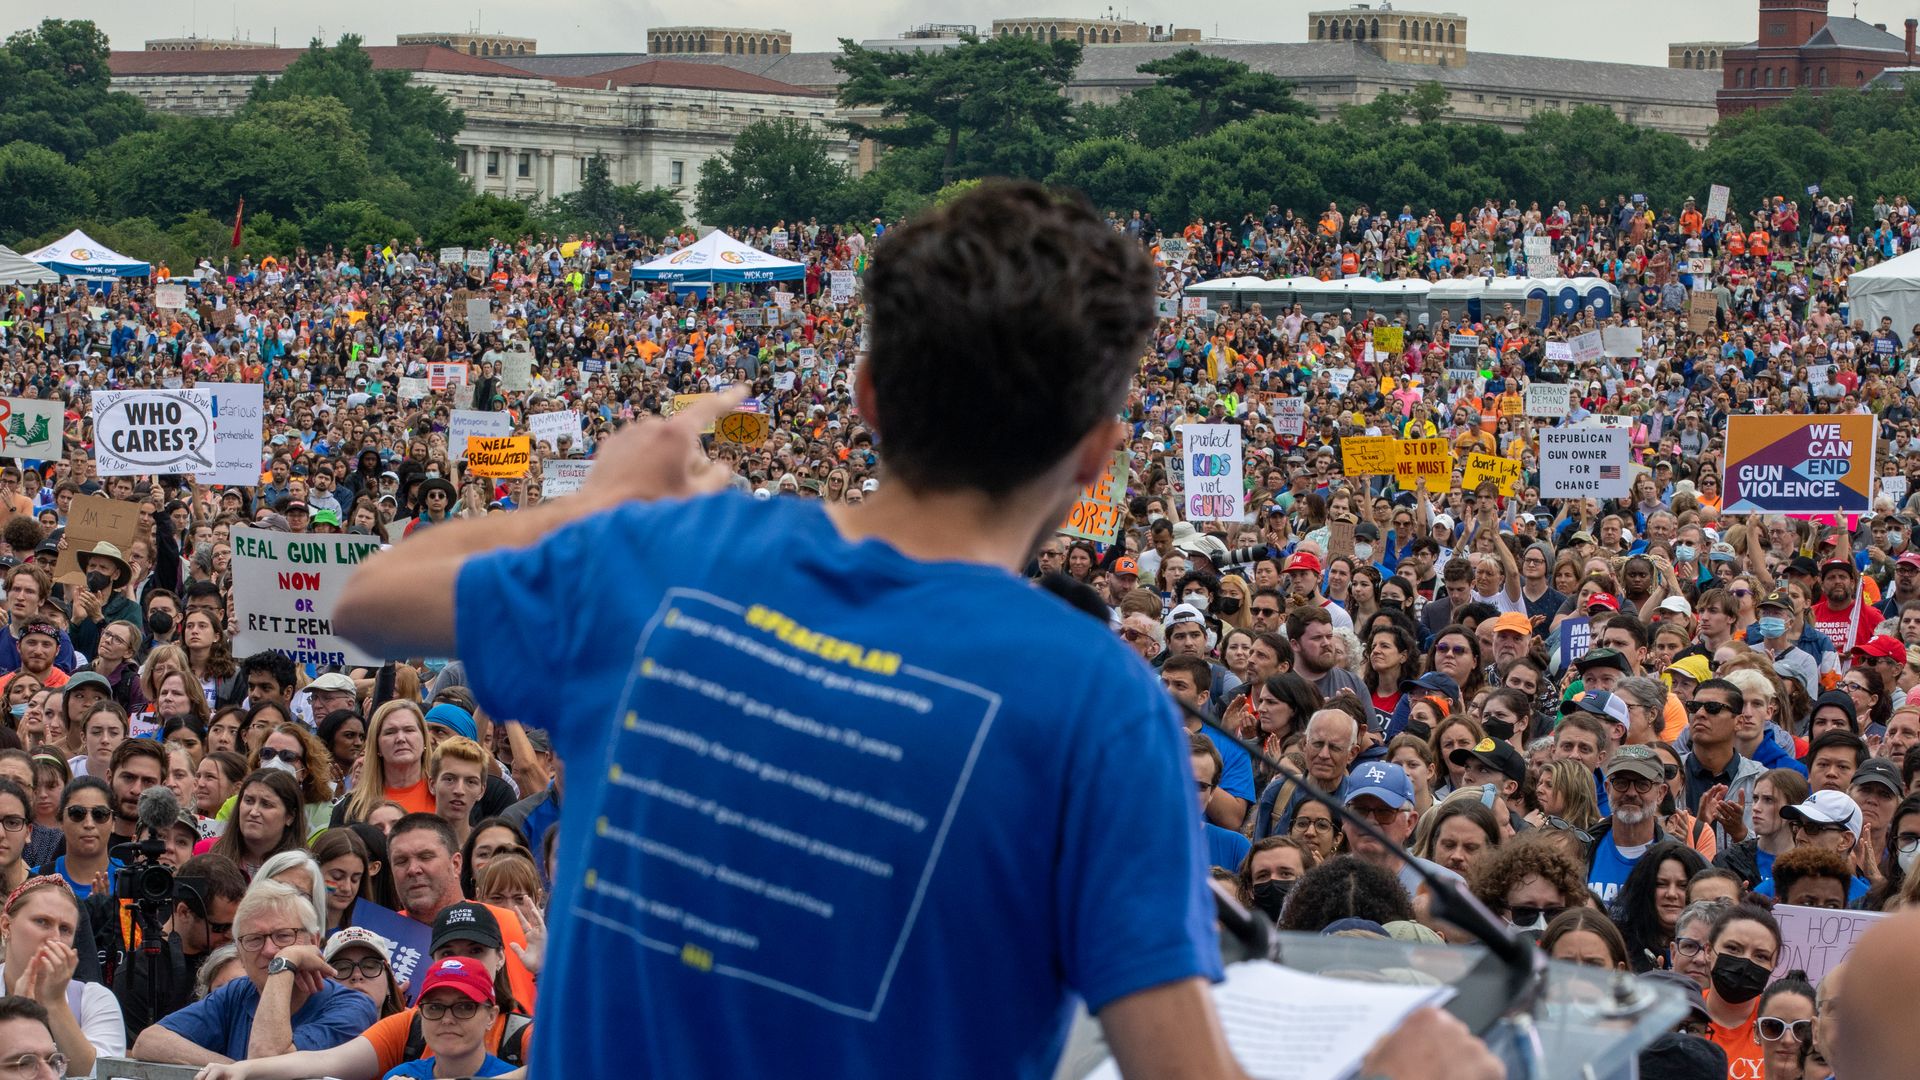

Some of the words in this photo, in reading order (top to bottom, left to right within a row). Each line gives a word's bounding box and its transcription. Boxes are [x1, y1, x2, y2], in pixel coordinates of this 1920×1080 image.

[658, 272, 684, 281] WCK.org
[744, 271, 774, 280] WCK.org
[1450, 370, 1475, 379] ALIVE
[1530, 386, 1567, 395] VETERANS
[212, 397, 257, 418] efarious
[1290, 399, 1301, 407] HEY
[1531, 396, 1563, 405] DEMAND
[124, 402, 181, 425] WHO
[1600, 415, 1618, 424] NRA
[1279, 420, 1298, 428] KILL
[1809, 424, 1841, 440] WE
[112, 427, 198, 452] CARES?
[213, 426, 254, 443] eprehensible
[1190, 428, 1232, 452] protect
[1547, 434, 1612, 443] REPUBLICAN
[1404, 442, 1440, 456] STOP.
[1548, 450, 1568, 460] GUN
[1571, 450, 1607, 460] OWNER
[1808, 441, 1852, 457] CAN
[210, 458, 254, 472] ccomplices
[1192, 453, 1231, 476] KIDS
[1397, 462, 1412, 475] WE
[1416, 461, 1448, 474] MUST.
[1472, 456, 1496, 472] don't
[1500, 462, 1518, 476] look
[1569, 465, 1590, 473] FOR
[1808, 459, 1850, 475] END
[558, 470, 586, 478] REQUIRE
[1739, 465, 1783, 481] GUN
[1200, 477, 1222, 494] not
[1555, 481, 1599, 490] CHANGE
[1738, 482, 1840, 498] VIOLENCE.
[1885, 480, 1904, 490] GUNS
[1190, 494, 1235, 517] GUNS
[80, 508, 98, 528] AM
[107, 514, 123, 529] I
[1062, 500, 1120, 537] ORE!
[235, 536, 278, 560] REAL
[287, 541, 327, 564] GUN
[278, 572, 321, 591] NOW
[295, 598, 315, 613] OR
[248, 613, 334, 636] RETIREM
[1571, 624, 1591, 636] MA
[297, 637, 317, 649] IN
[1570, 636, 1591, 648] FO
[743, 697, 774, 717] gun
[773, 708, 824, 738] deaths
[861, 736, 903, 763] years
[759, 762, 789, 784] gun
[1364, 766, 1386, 783] AF
[446, 916, 476, 925] MATTER
[1772, 913, 1794, 942] I
[1807, 916, 1866, 945] HOPE
[1771, 945, 1838, 979] ON'T
